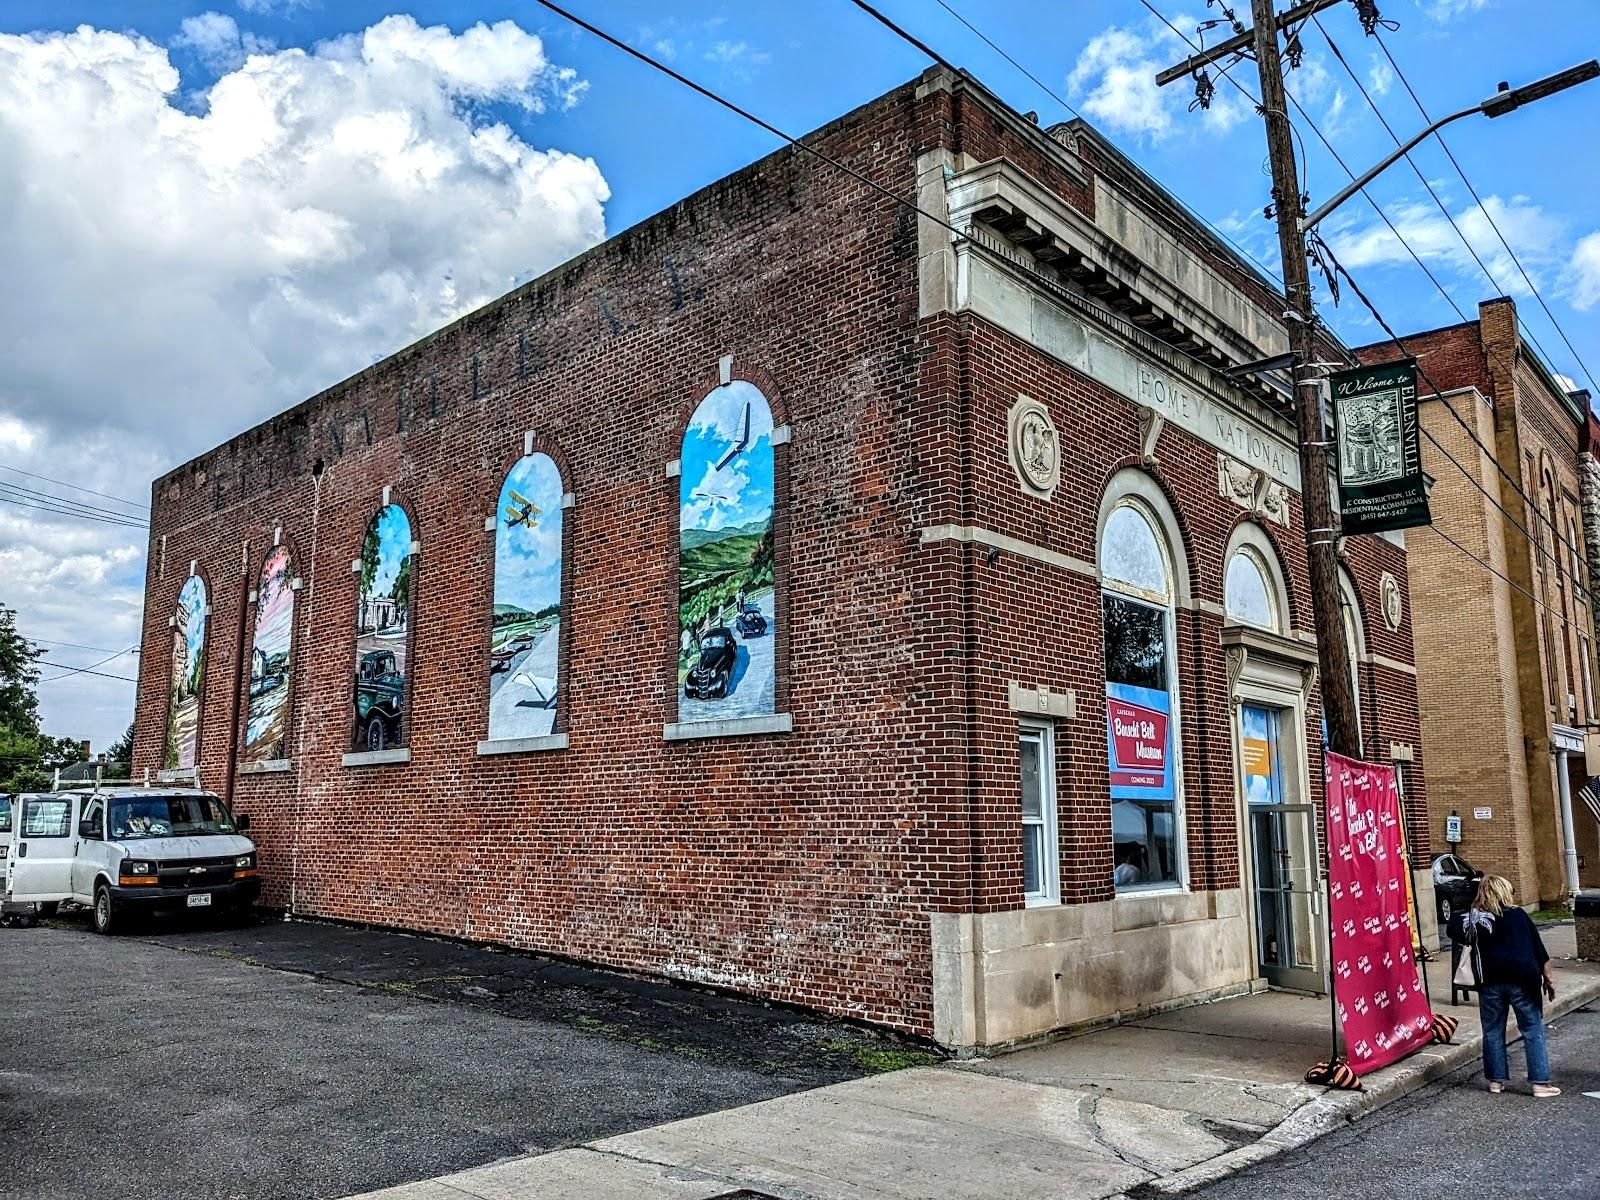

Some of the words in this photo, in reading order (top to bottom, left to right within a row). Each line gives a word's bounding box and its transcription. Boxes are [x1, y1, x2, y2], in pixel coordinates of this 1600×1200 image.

[1337, 376, 1395, 395] Welcome
[1396, 375, 1410, 384] to
[1139, 369, 1190, 419] HOME
[1214, 414, 1288, 475] NATIONAL
[1401, 384, 1418, 476] ELLENVILLE
[1341, 496, 1425, 515] RESIDENTIAL/COMMERCIAL
[1353, 492, 1405, 505] CONSTRUCTION,
[1405, 489, 1417, 497] LLC
[1140, 720, 1155, 740] Belt
[1135, 740, 1163, 760] Museum
